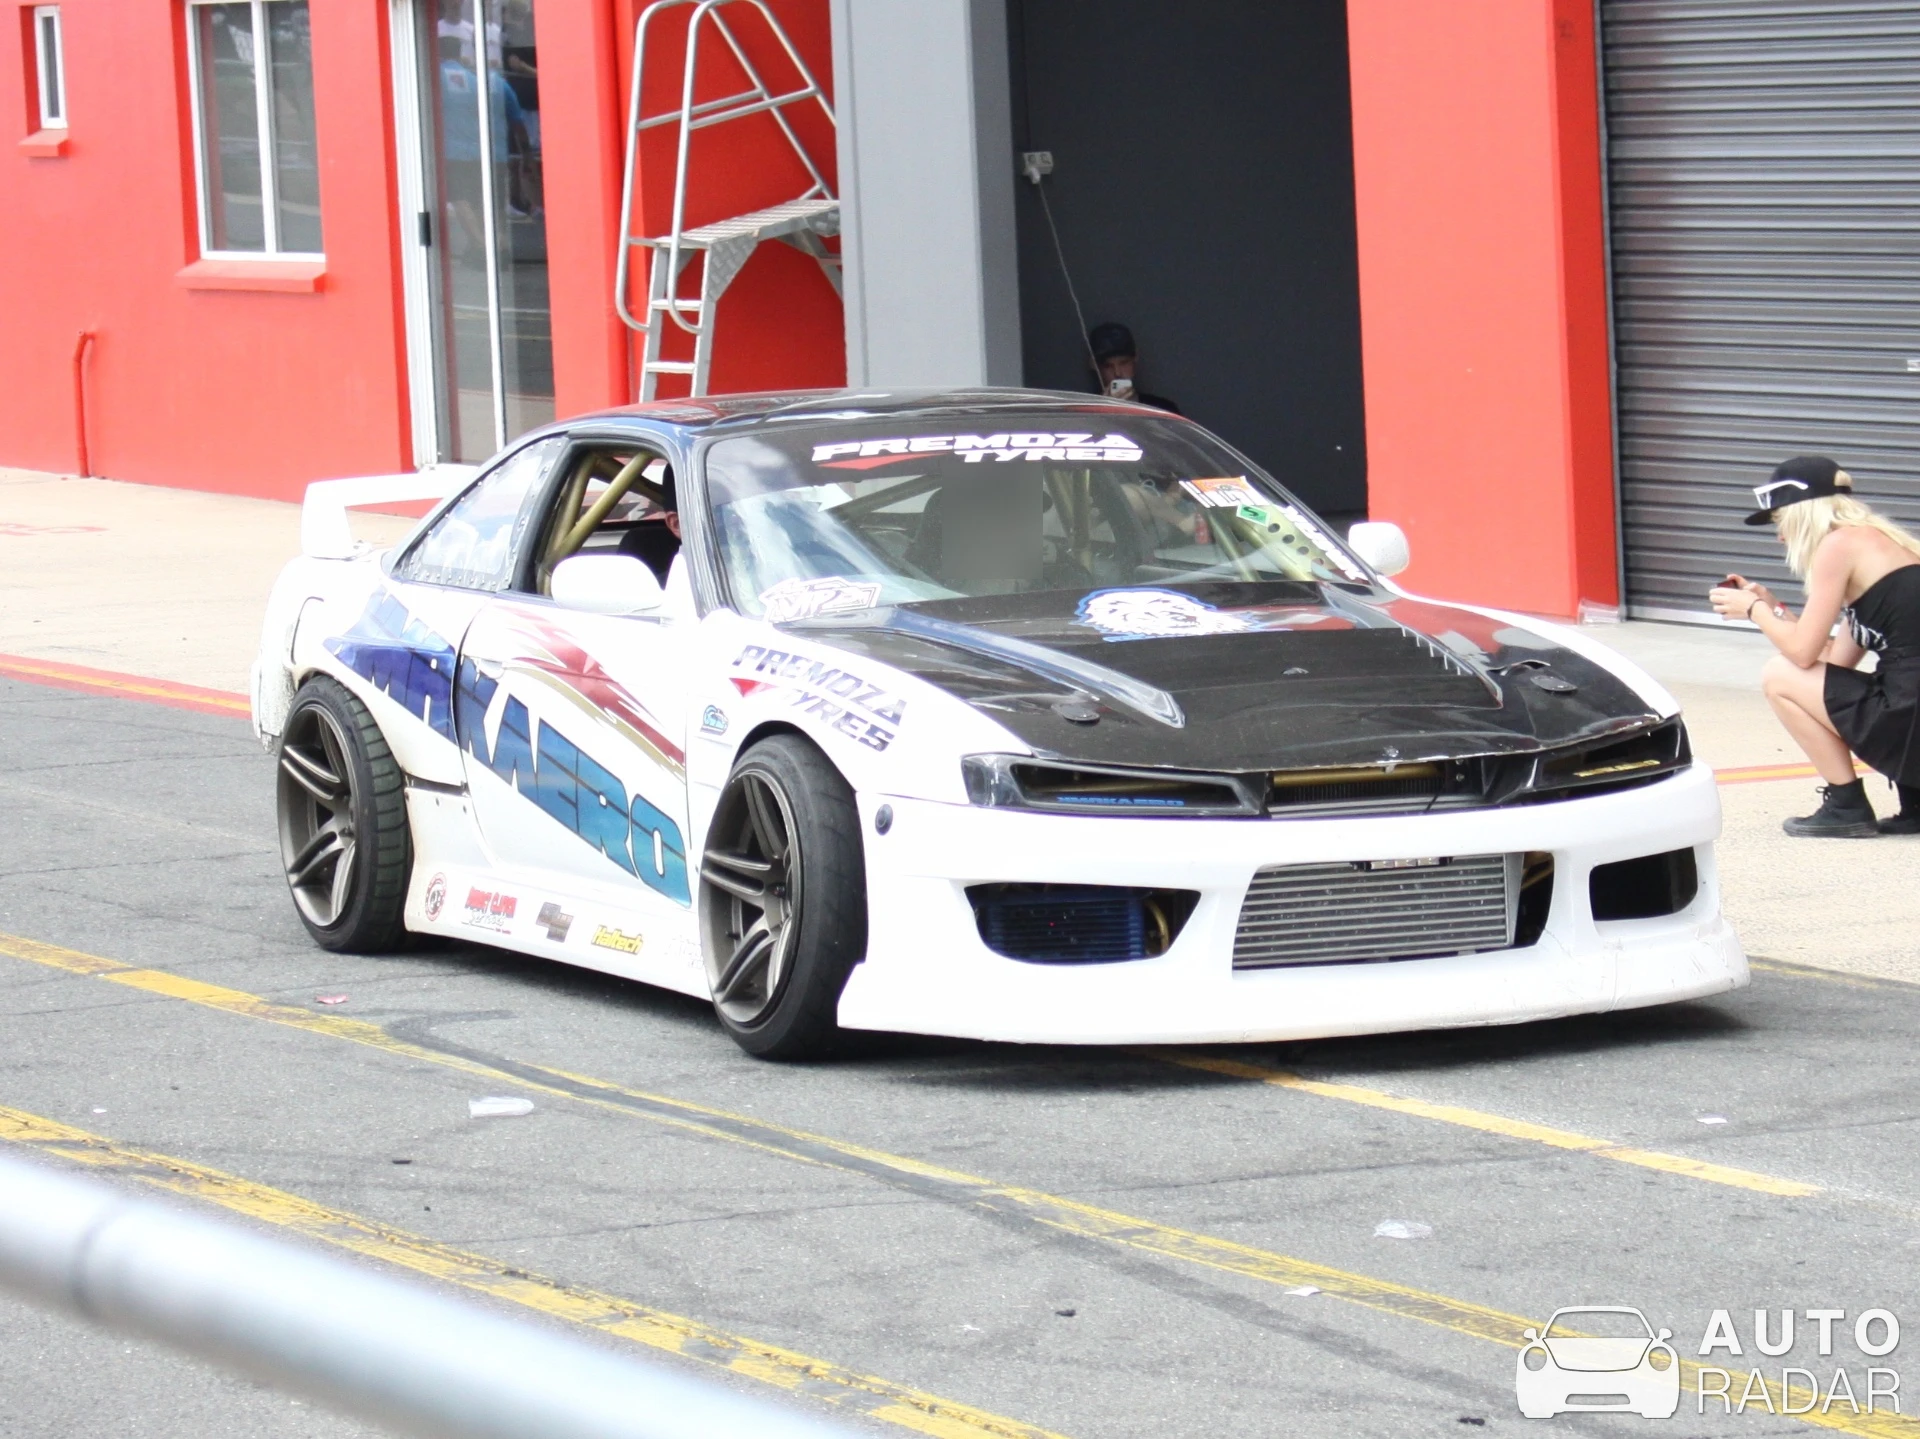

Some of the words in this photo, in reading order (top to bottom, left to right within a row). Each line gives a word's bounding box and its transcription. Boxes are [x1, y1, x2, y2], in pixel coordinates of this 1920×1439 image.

[812, 433, 1139, 462] PREMOZA
[955, 448, 1143, 463] TYRES
[732, 645, 907, 726] PREMOZA
[787, 688, 895, 752] TYRES
[591, 925, 644, 956] Haltech
